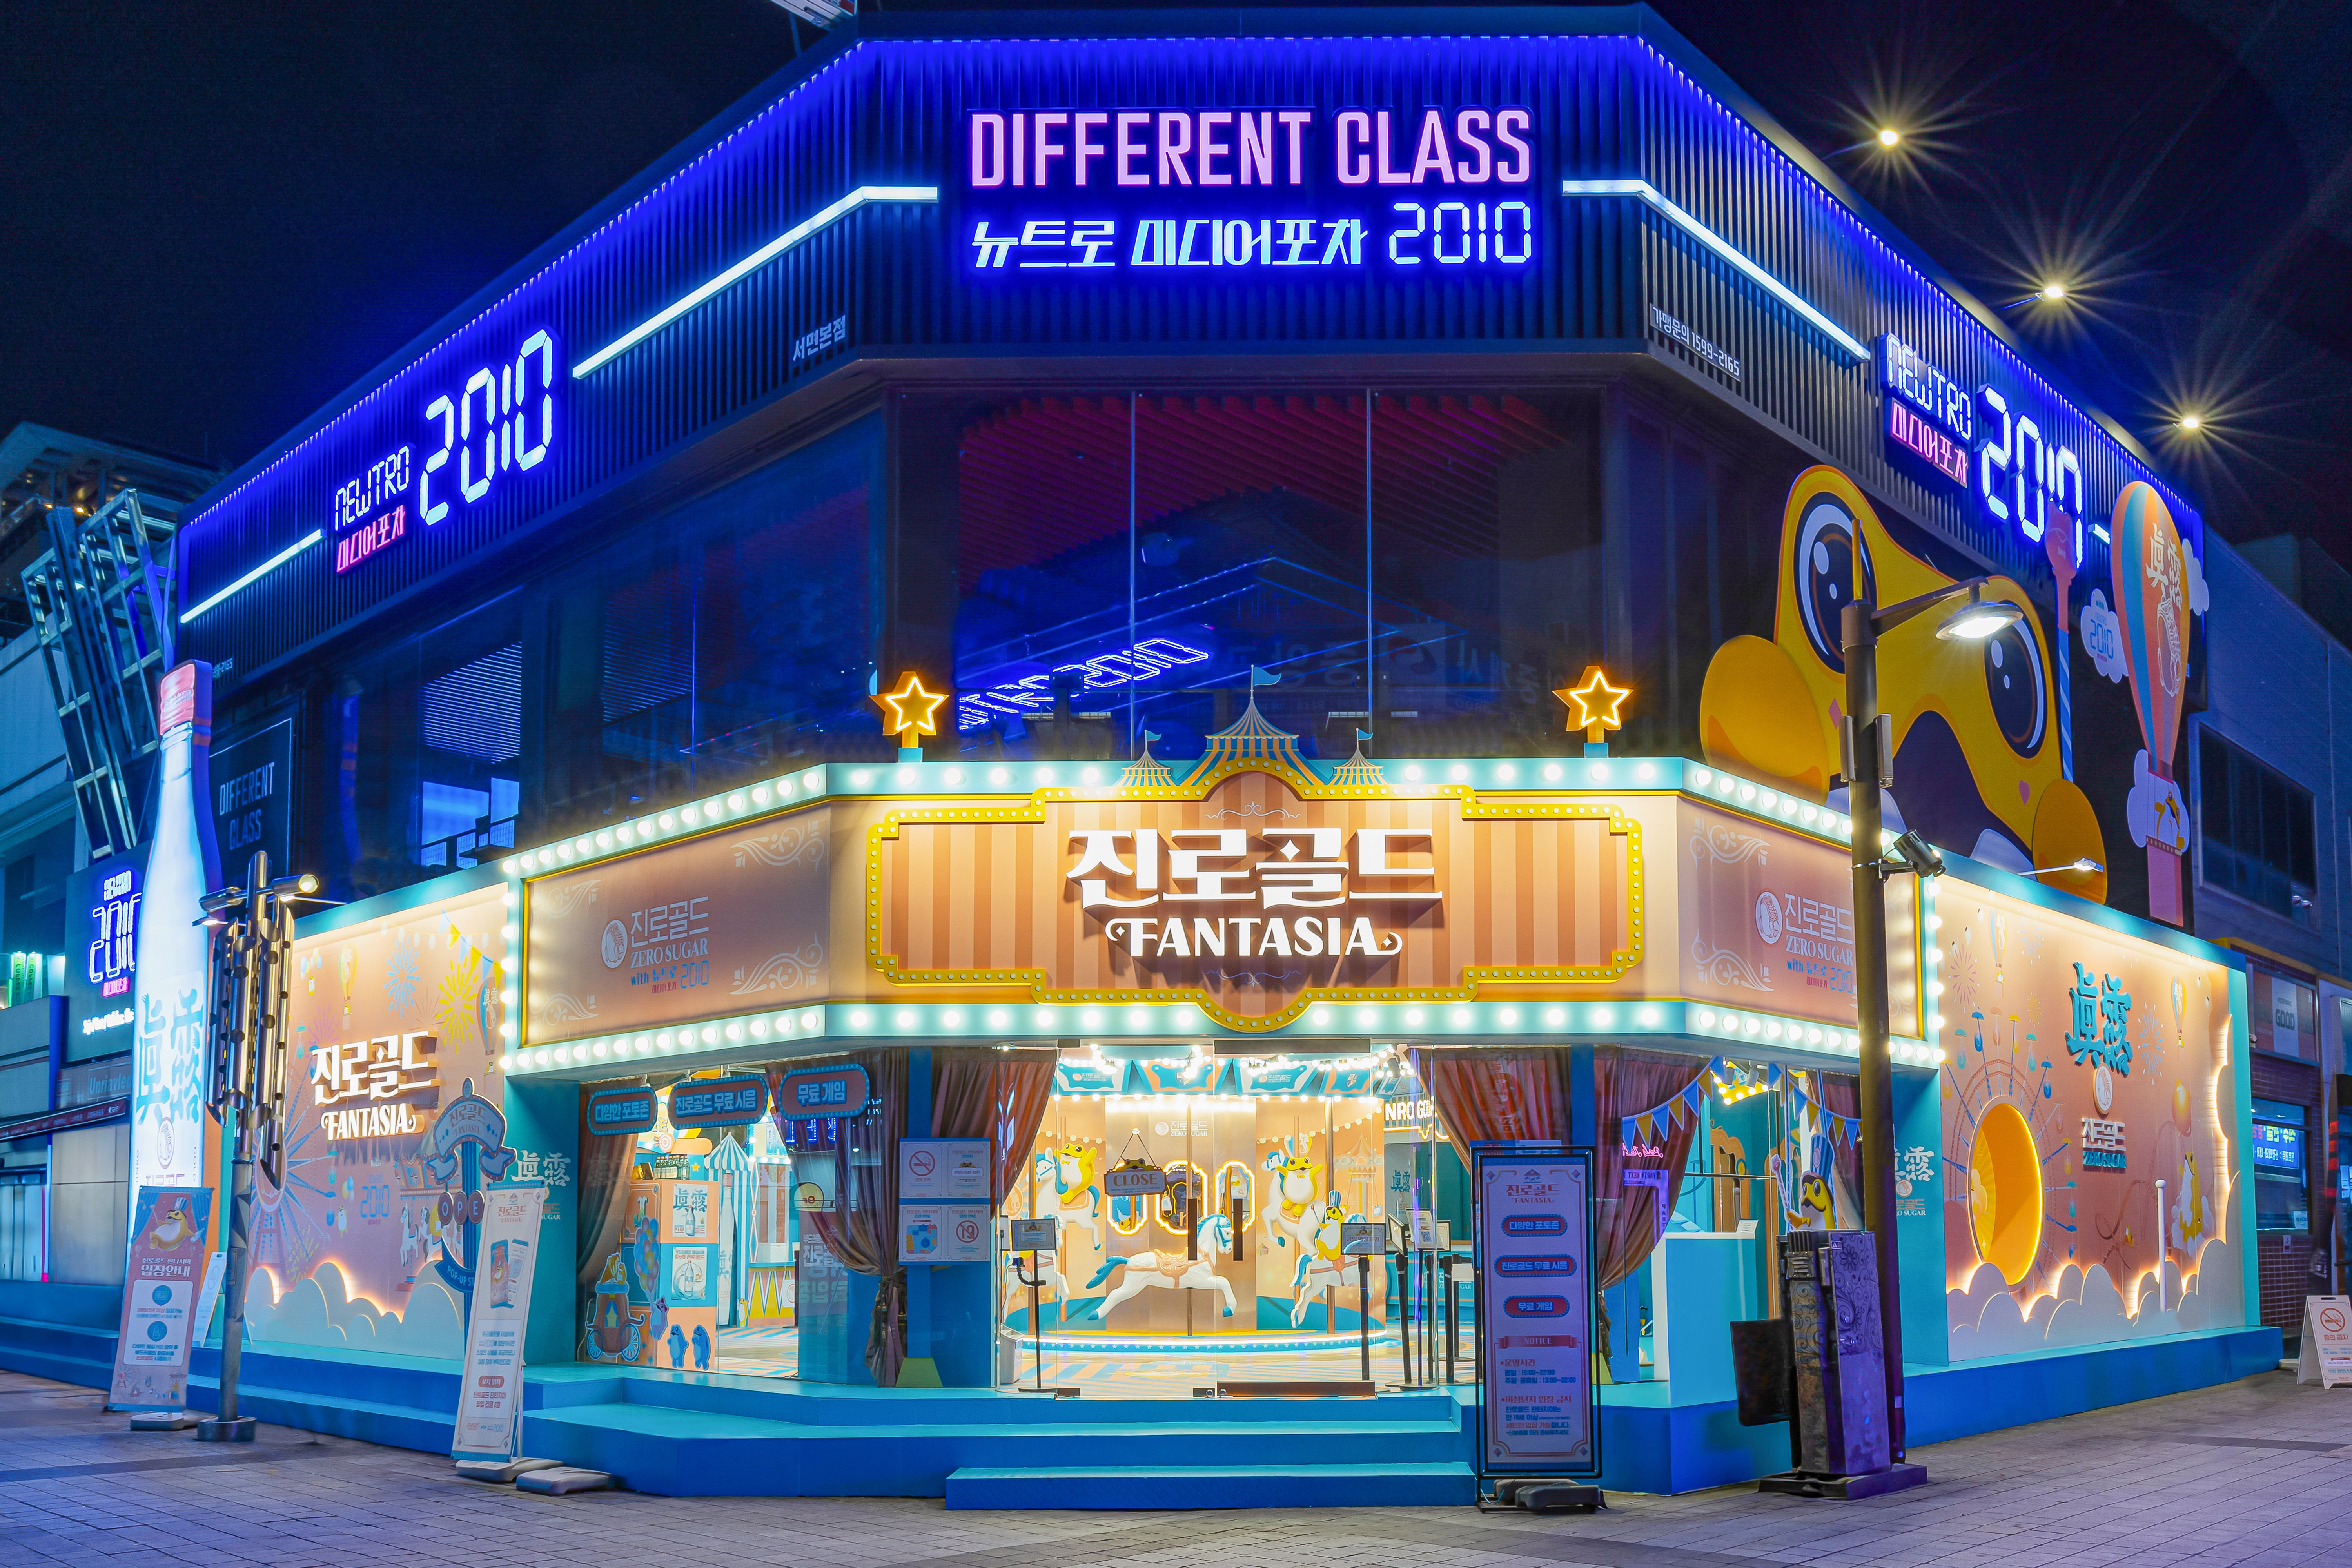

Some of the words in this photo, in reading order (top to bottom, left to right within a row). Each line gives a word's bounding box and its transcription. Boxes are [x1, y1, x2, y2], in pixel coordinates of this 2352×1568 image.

[971, 111, 1311, 187] DIFFERENT
[1337, 110, 1532, 185] CLASS
[972, 220, 1116, 268] 뉴트로
[1131, 218, 1368, 266] 미디어포차
[1389, 201, 1532, 265] 2010
[793, 314, 846, 361] 서면본점
[1653, 307, 1689, 345] 가맹문의
[1692, 332, 1739, 376] 1599-2165
[1888, 336, 1971, 440] NEWTRO
[420, 329, 552, 526] 2010
[1891, 401, 1969, 485] 미디어포차
[335, 445, 409, 531] NEWTRO
[336, 505, 406, 573] 미디어포차
[2090, 619, 2114, 659] 2010
[219, 762, 275, 816] DIFFERENT
[229, 809, 261, 851] CLASS
[1065, 828, 1443, 910] 진로골드
[630, 896, 709, 948] 진로골드
[1784, 893, 1853, 945] 진로골드
[1104, 916, 1403, 956] FANTASIA
[1786, 935, 1817, 957] ZERO
[1817, 941, 1853, 966] SUGAR
[630, 946, 663, 969] ZERO
[665, 938, 709, 962] SUGAR
[630, 972, 650, 986] with
[680, 960, 709, 989] 2010
[1787, 958, 1803, 973] with
[1829, 967, 1853, 994] 2010
[2275, 1008, 2295, 1031] GOOD
[310, 1030, 438, 1106] 진로골드
[675, 1093, 713, 1116] 진로골드
[714, 1091, 735, 1113] 무료
[735, 1088, 757, 1109] 시음
[797, 1083, 820, 1105] 무료
[822, 1080, 847, 1103] 게임
[321, 1103, 417, 1140] FANTASIA
[449, 1103, 487, 1128] 진로골드
[595, 1103, 621, 1124] 다양한
[622, 1099, 650, 1122] 포토존
[1385, 1101, 1415, 1121] NRO
[454, 1124, 482, 1136] FANTASIA
[2082, 1117, 2127, 1151] 진로골드
[2083, 1151, 2103, 1167] ZERO
[2103, 1152, 2127, 1168] SUGAR
[1113, 1173, 1158, 1187] CLOSE
[1505, 1184, 1561, 1196] 진로골드
[360, 1185, 390, 1218] 2010
[497, 1205, 527, 1217] 진로골드
[1896, 1198, 1925, 1210] 로골드
[1509, 1221, 1534, 1230] 다양한
[1535, 1221, 1559, 1229] 포토존
[141, 1264, 191, 1277] 입장안내
[446, 1265, 467, 1285] POP-UP
[1501, 1262, 1533, 1270] 진로골드
[1534, 1261, 1551, 1270] 무료
[1551, 1261, 1568, 1270] 시음
[1518, 1302, 1534, 1310] 무료
[1535, 1302, 1553, 1310] 게임
[1504, 1359, 1535, 1367] 운영시간
